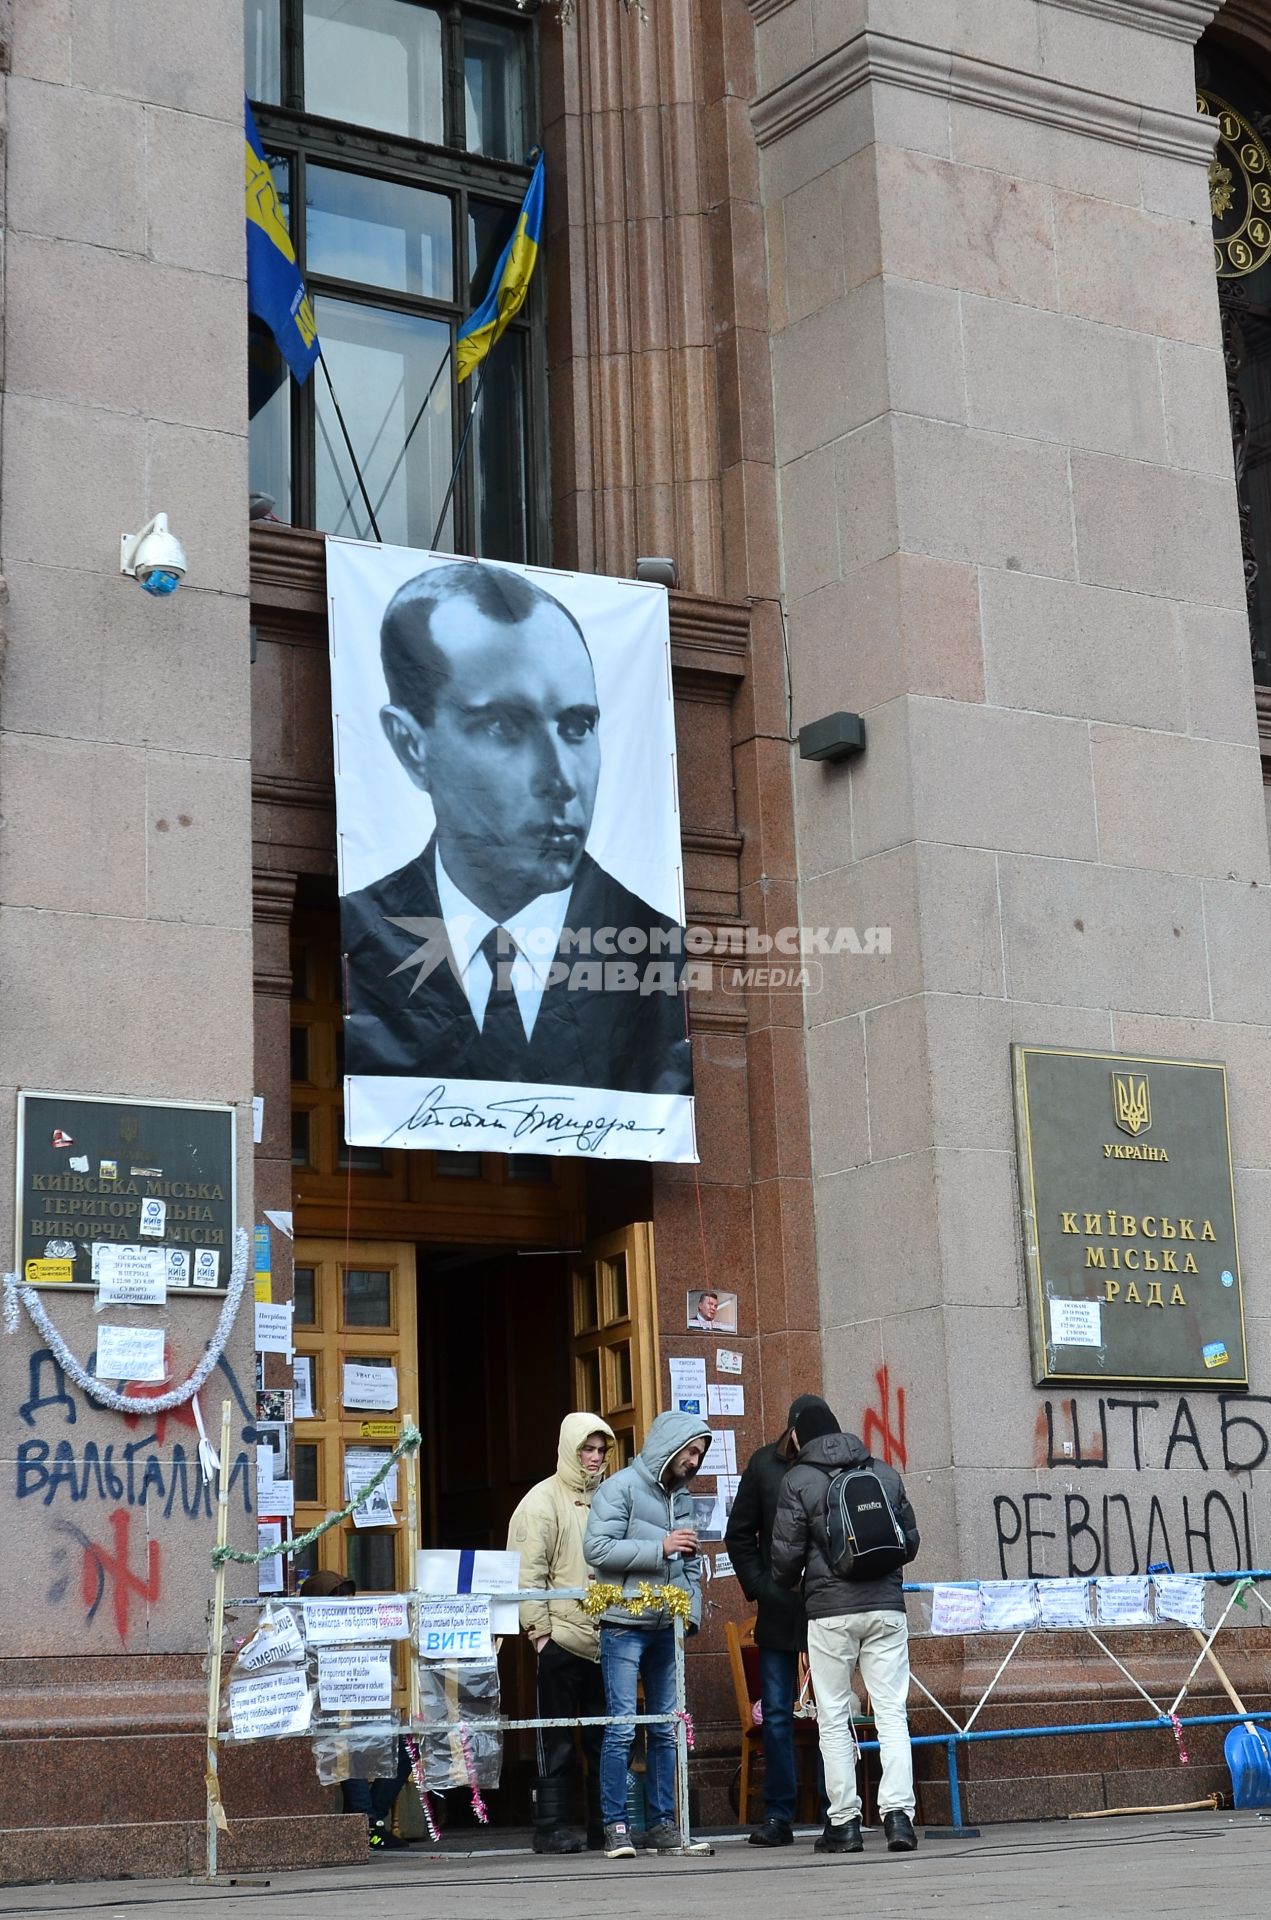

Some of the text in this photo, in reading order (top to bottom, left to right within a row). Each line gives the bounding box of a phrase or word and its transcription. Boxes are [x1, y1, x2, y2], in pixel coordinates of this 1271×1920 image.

[1223, 117, 1232, 136] 1
[1249, 150, 1258, 168] 2
[1262, 189, 1271, 206] 3
[1253, 224, 1264, 242] 4
[1237, 245, 1246, 263] 5
[1103, 1144, 1170, 1162] УКРАЇНА
[32, 1172, 139, 1196] КИЇВСЬКА
[146, 1180, 224, 1200] МІСЬКА
[42, 1198, 215, 1222] ТЕРИТОРЬНА
[31, 1220, 224, 1244] ВИБОРЧА МІСІЯ
[1061, 1210, 1217, 1242] КИЇВСЬКА
[1086, 1246, 1199, 1274] МІСЬКА
[167, 1267, 186, 1277] КИЇВ
[197, 1267, 215, 1277] КИЇВ
[1104, 1281, 1186, 1308] РАДА
[259, 1312, 286, 1321] Потрібно
[1045, 1394, 1271, 1471] ШТАБ
[307, 1606, 315, 1617] Мы
[322, 1607, 348, 1619] русскими
[357, 1606, 373, 1617] крови
[378, 1603, 403, 1617] братство
[421, 1604, 443, 1615] Спасибо
[443, 1605, 464, 1615] говорю
[309, 1619, 317, 1629] Но
[318, 1619, 340, 1629] никогда
[353, 1616, 378, 1629] братству
[433, 1619, 450, 1627] только
[451, 1618, 464, 1628] Крым
[465, 1616, 488, 1626] достался
[427, 1631, 482, 1650] ВИТЕ
[320, 1656, 337, 1664] Сегодня
[338, 1656, 356, 1666] пропуск
[353, 1668, 370, 1676] Майдан
[361, 1696, 377, 1704] русском
[250, 1705, 277, 1718] свободный
